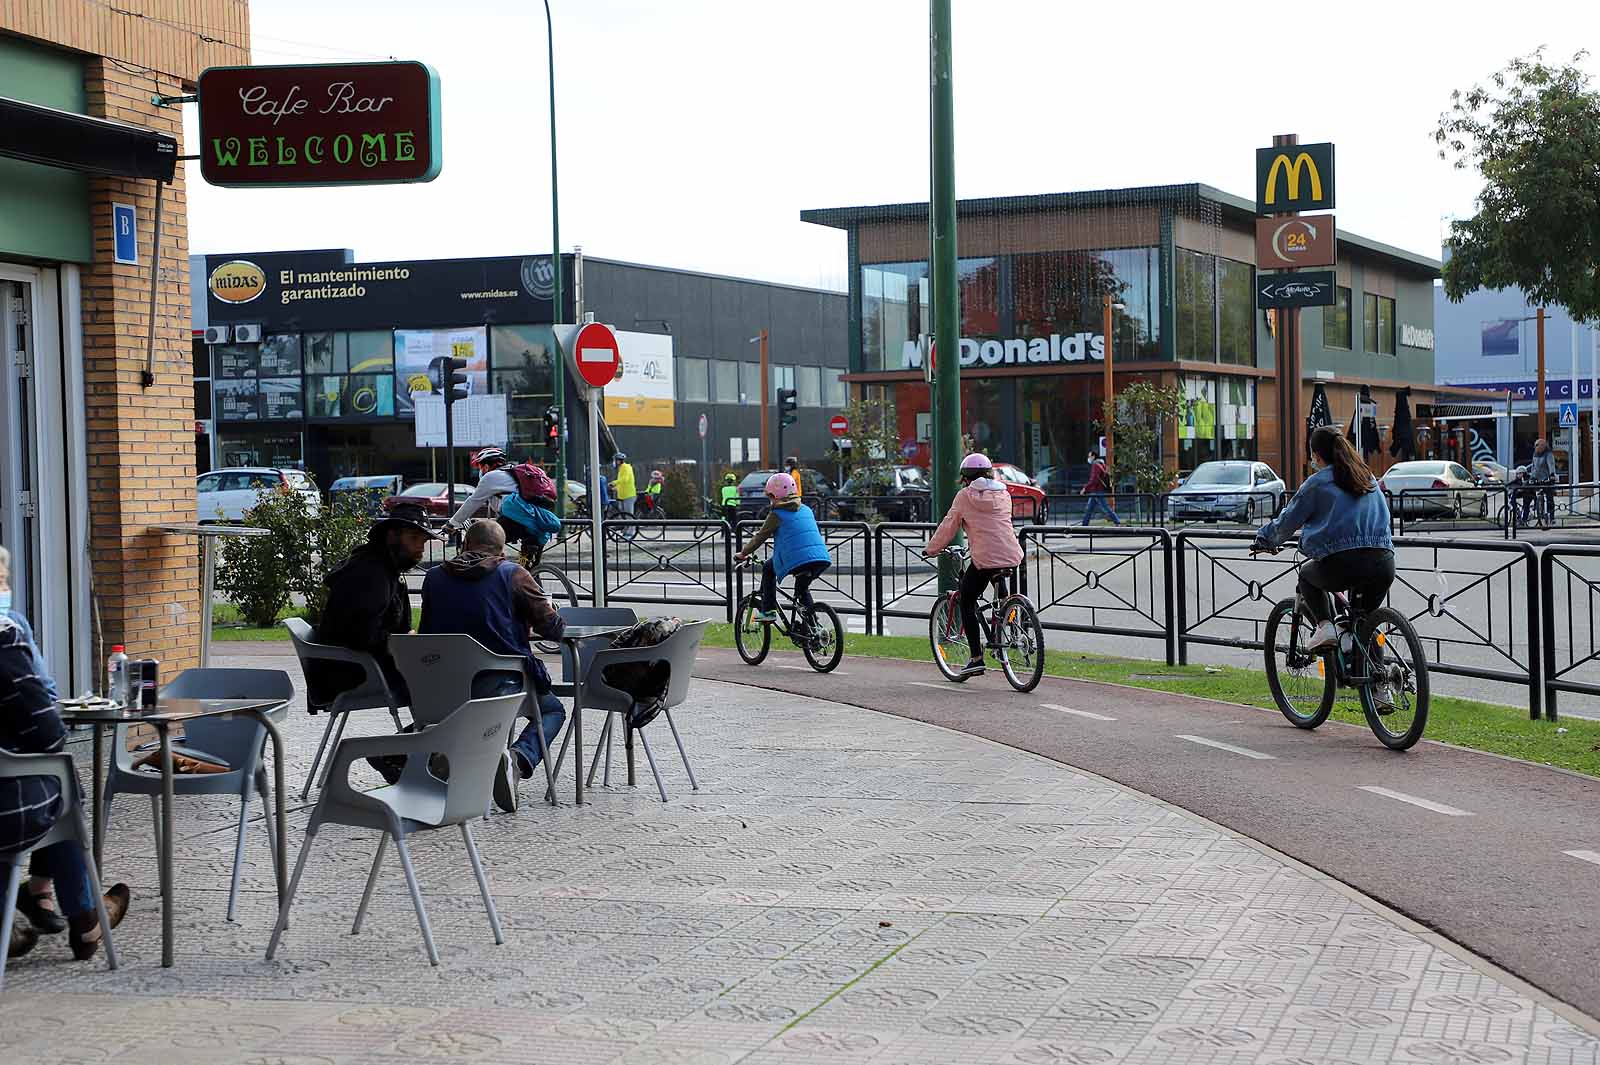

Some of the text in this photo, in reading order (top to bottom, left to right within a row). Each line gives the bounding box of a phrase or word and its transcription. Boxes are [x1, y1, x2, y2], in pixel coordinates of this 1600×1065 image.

[239, 81, 393, 125] Cafe Bar
[212, 130, 416, 168] WELCOME
[121, 216, 130, 236] B
[1287, 233, 1307, 247] 24
[280, 266, 410, 284] El mantenimiento
[281, 285, 367, 304] garantizado
[460, 289, 519, 299] www.midas.es
[902, 332, 1104, 369] MDonald's
